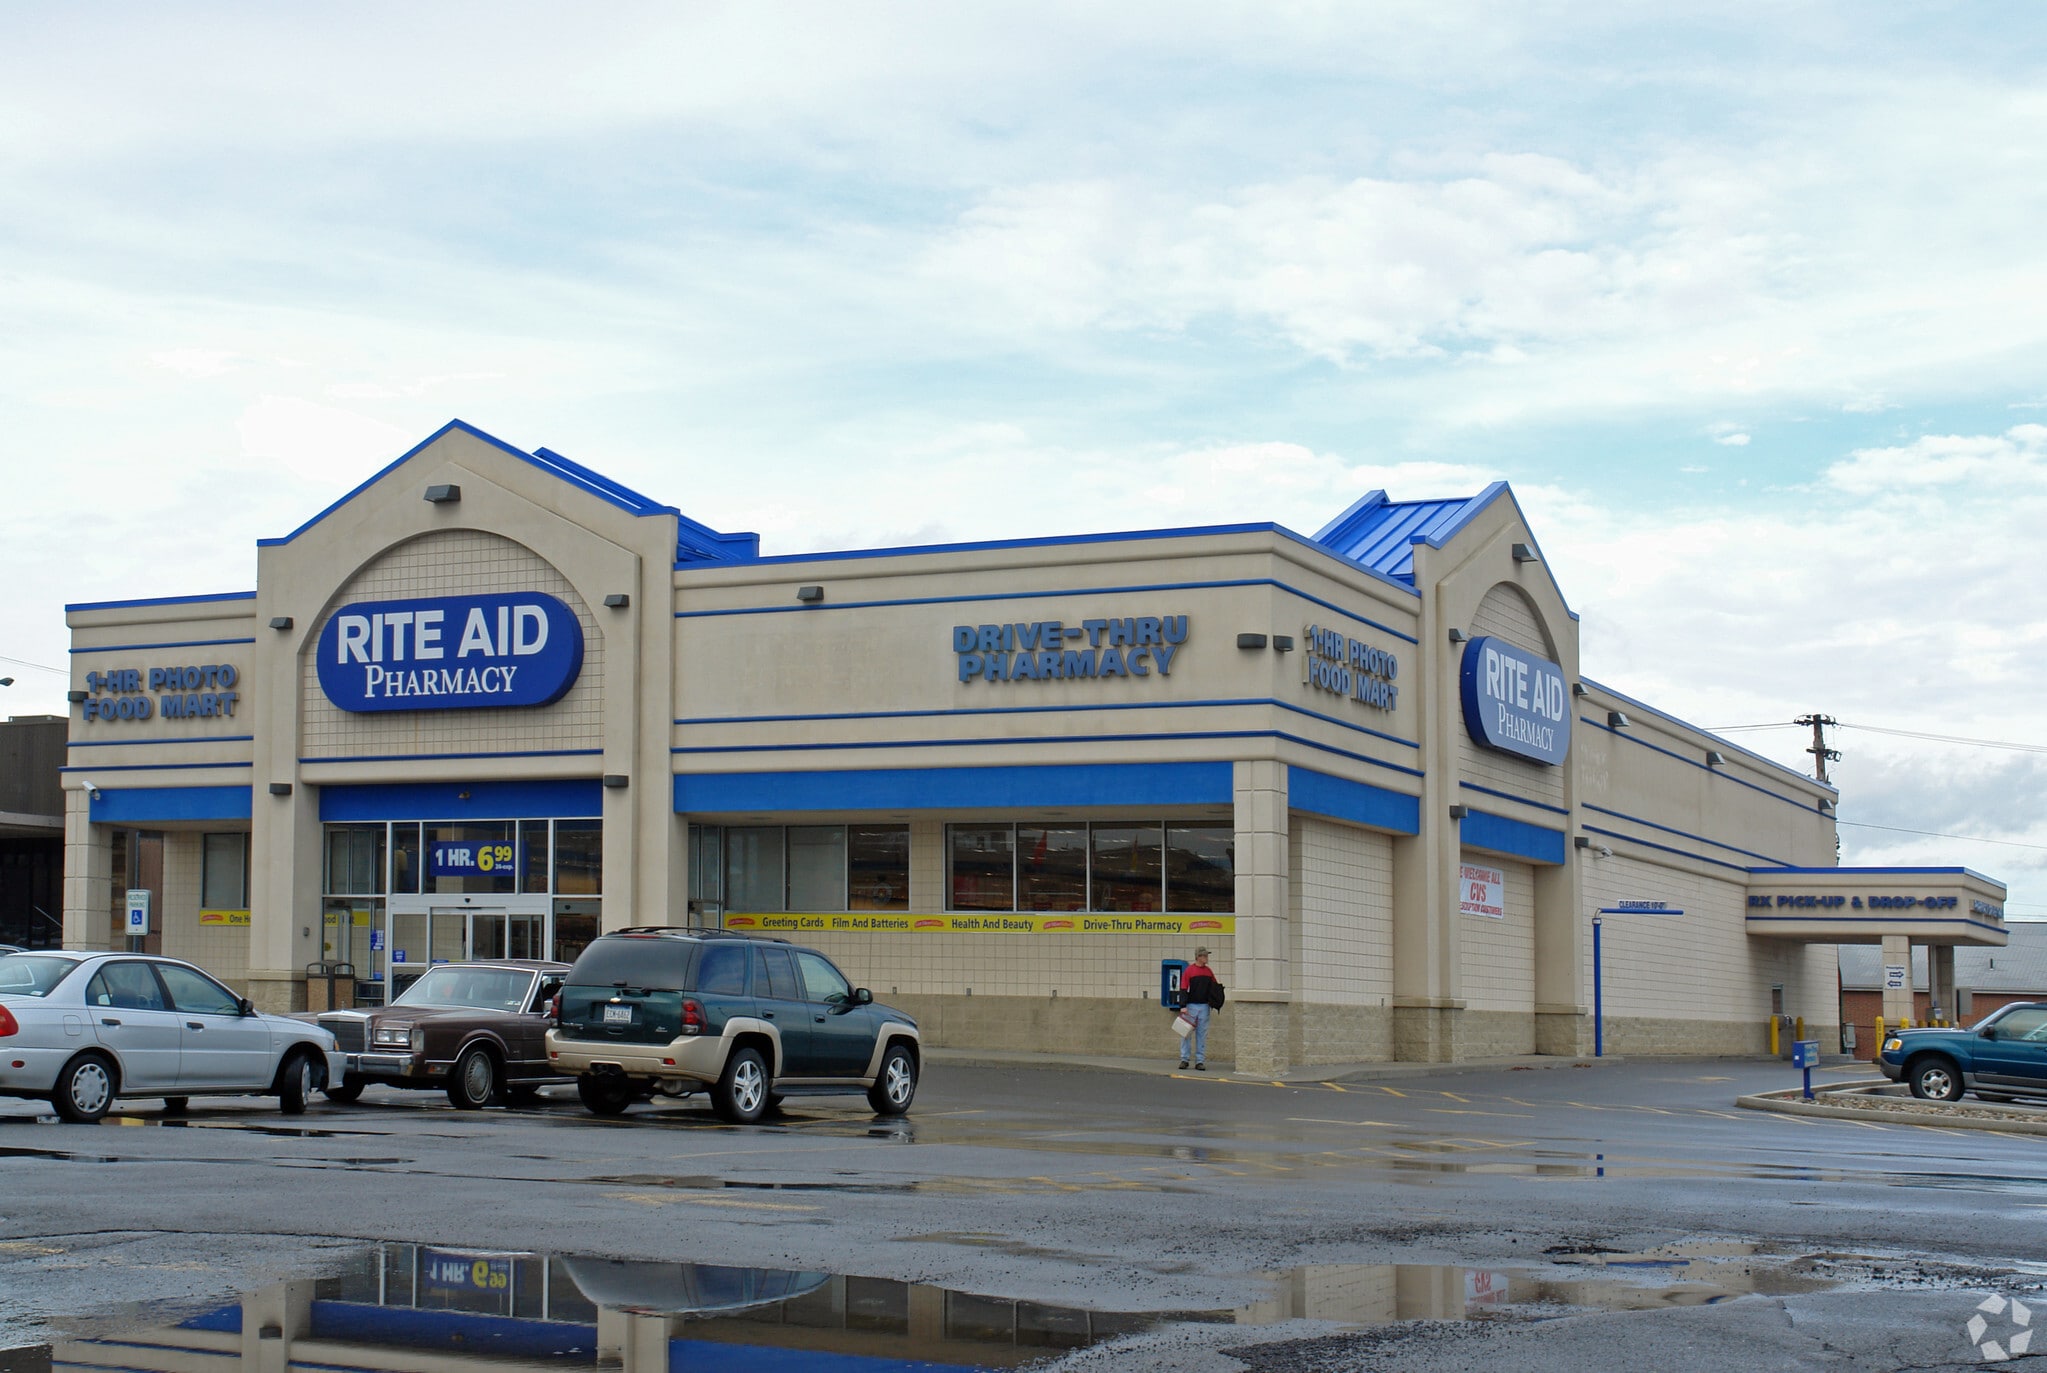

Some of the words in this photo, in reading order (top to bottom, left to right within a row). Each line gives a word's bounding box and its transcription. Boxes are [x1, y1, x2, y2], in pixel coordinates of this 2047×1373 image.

[337, 609, 444, 664] RITE
[456, 604, 549, 658] AID
[953, 614, 1189, 653] DRIVE-THRU
[958, 645, 1178, 683] PHARMACY
[1306, 624, 1344, 661] 1-HR
[1348, 638, 1398, 680] PHOTO
[86, 668, 144, 694] 1-HR
[149, 663, 239, 691] PHOTO
[364, 663, 518, 698] PHARMACY
[1306, 655, 1351, 695] FOOD
[1356, 672, 1399, 712] MART
[1486, 647, 1528, 710] RITE
[1532, 669, 1563, 721] AID
[83, 696, 153, 721] FOOD
[160, 691, 238, 718] MART
[1498, 702, 1554, 752] PHARMACY
[447, 848, 475, 867] HR.
[1470, 882, 1487, 902] CVS
[1618, 900, 1651, 909] CLEARANCE
[1747, 895, 1773, 908] RX
[1776, 895, 1846, 908] PICK-UP
[1850, 896, 1864, 909] &
[1868, 896, 1958, 910] DROP-OFF
[229, 914, 243, 923] One
[762, 917, 798, 930] Greeting
[800, 917, 825, 928] Cards
[832, 917, 850, 928] Film
[851, 917, 869, 929] And
[871, 917, 909, 930] Batteries
[951, 918, 980, 929] Health
[982, 918, 1000, 930] And
[1002, 919, 1034, 932] Beauty
[1083, 918, 1133, 931] Drive-Thru
[1135, 919, 1183, 933] Pharmacy
